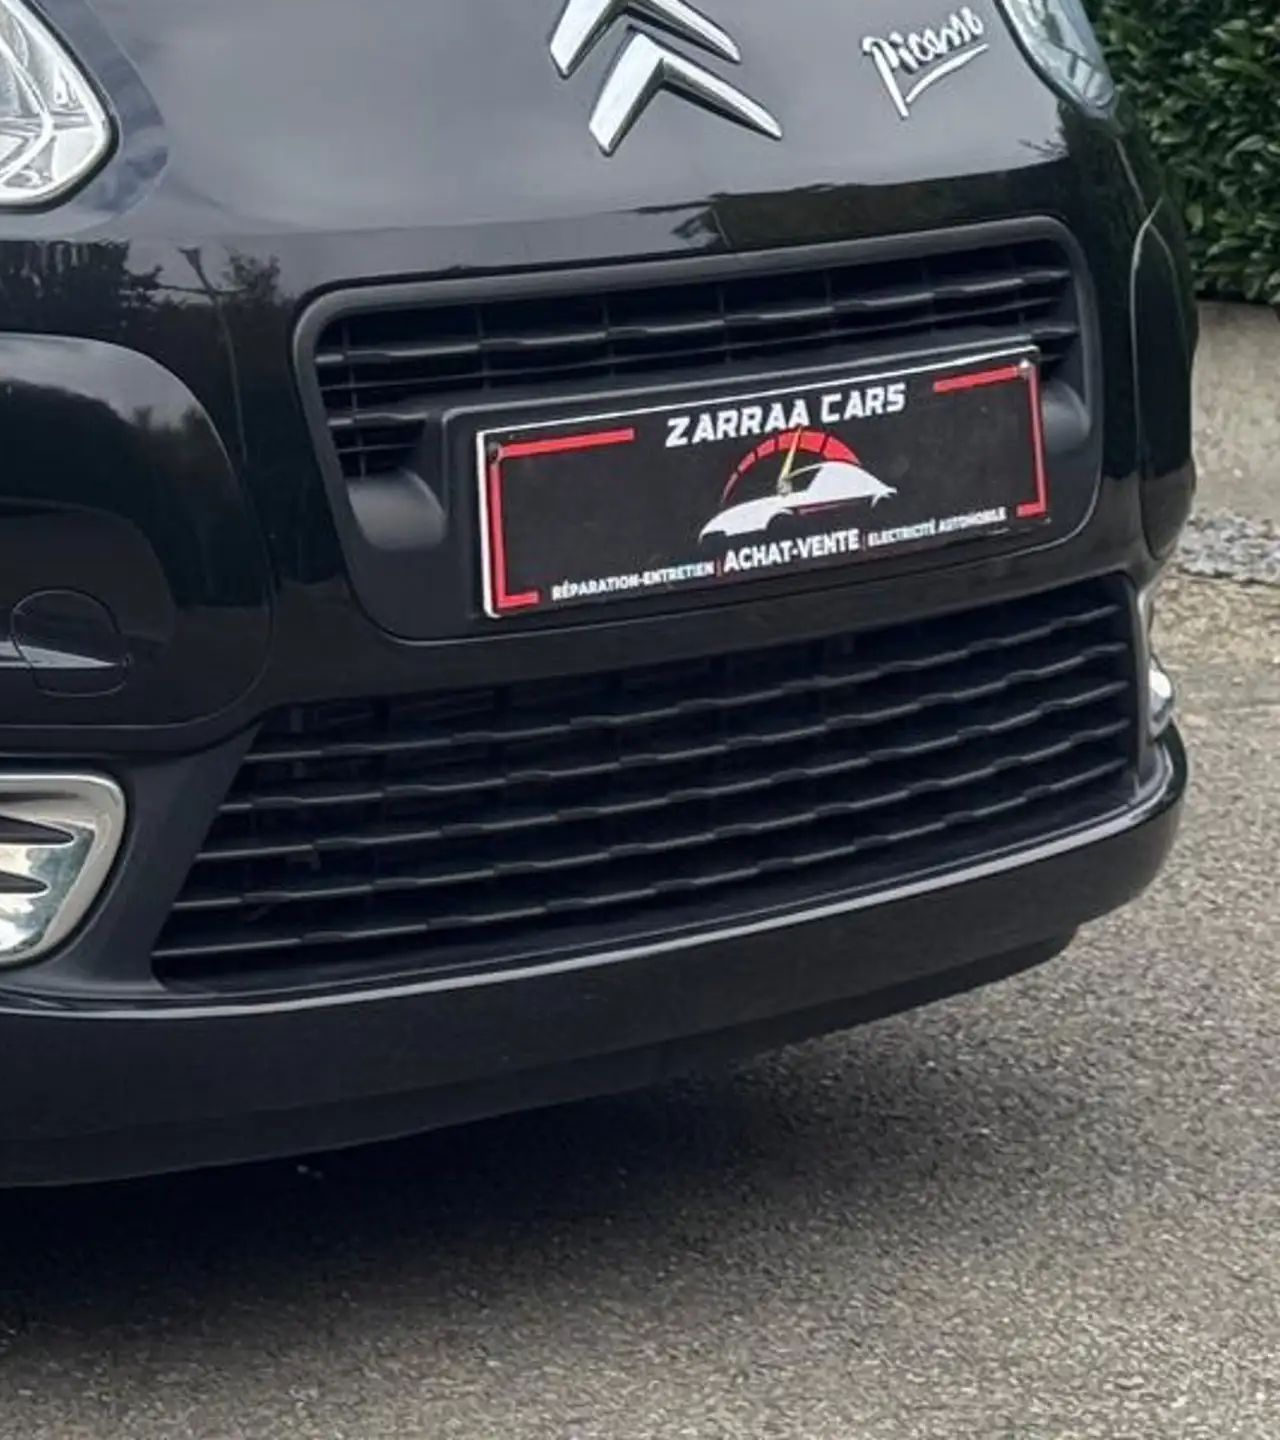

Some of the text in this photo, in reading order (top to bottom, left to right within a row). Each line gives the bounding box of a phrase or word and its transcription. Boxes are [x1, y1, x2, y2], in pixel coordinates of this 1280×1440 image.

[665, 382, 907, 448] ZARRAA CARS
[551, 560, 715, 602] RÉPARATION-ENTRETIEN
[723, 527, 860, 574] ACHAT-VENTE
